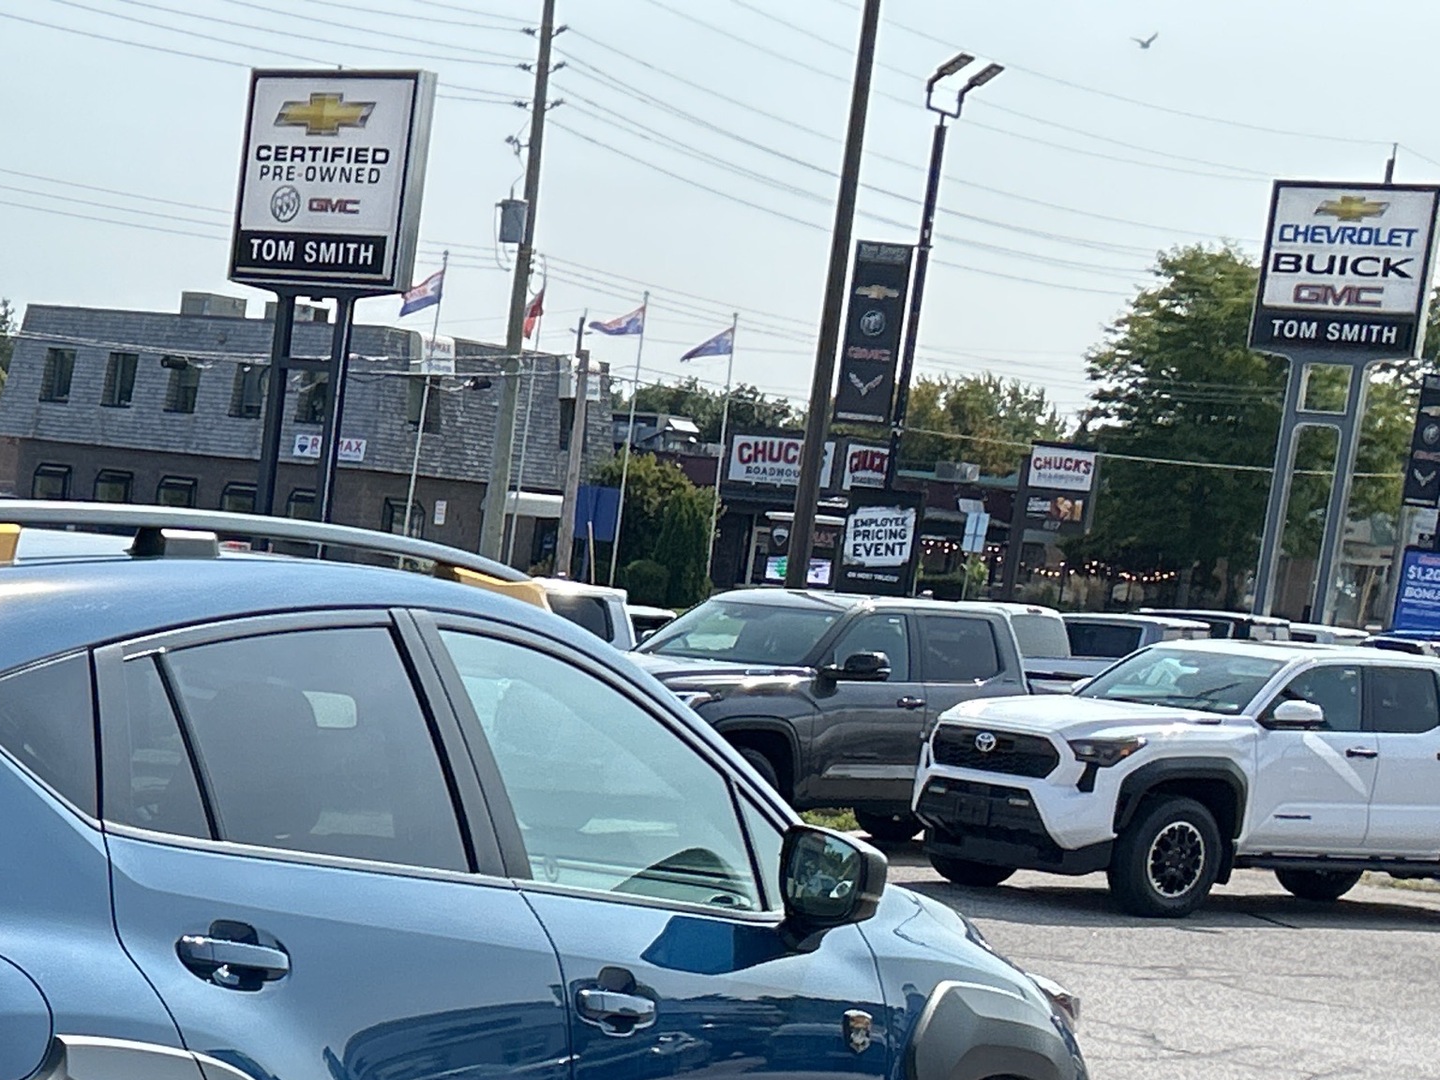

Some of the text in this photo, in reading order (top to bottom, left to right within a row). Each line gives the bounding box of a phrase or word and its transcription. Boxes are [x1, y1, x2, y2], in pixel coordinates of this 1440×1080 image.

[256, 145, 390, 164] CERTIFIED
[259, 165, 381, 184] PRE-OWNED
[308, 198, 360, 214] GMC
[1278, 224, 1420, 248] CHEVROLET
[250, 239, 374, 265] TOM SMITH
[1271, 253, 1415, 280] BUICK
[1293, 283, 1385, 308] GMC
[1271, 319, 1398, 345] TOM SMITH
[310, 436, 363, 455] RAX
[737, 440, 827, 470] CHUC
[745, 465, 801, 478] ROADHOU
[853, 517, 908, 528] EMPLOYEE
[853, 528, 907, 541] PRICING
[853, 542, 907, 557] EVENT
